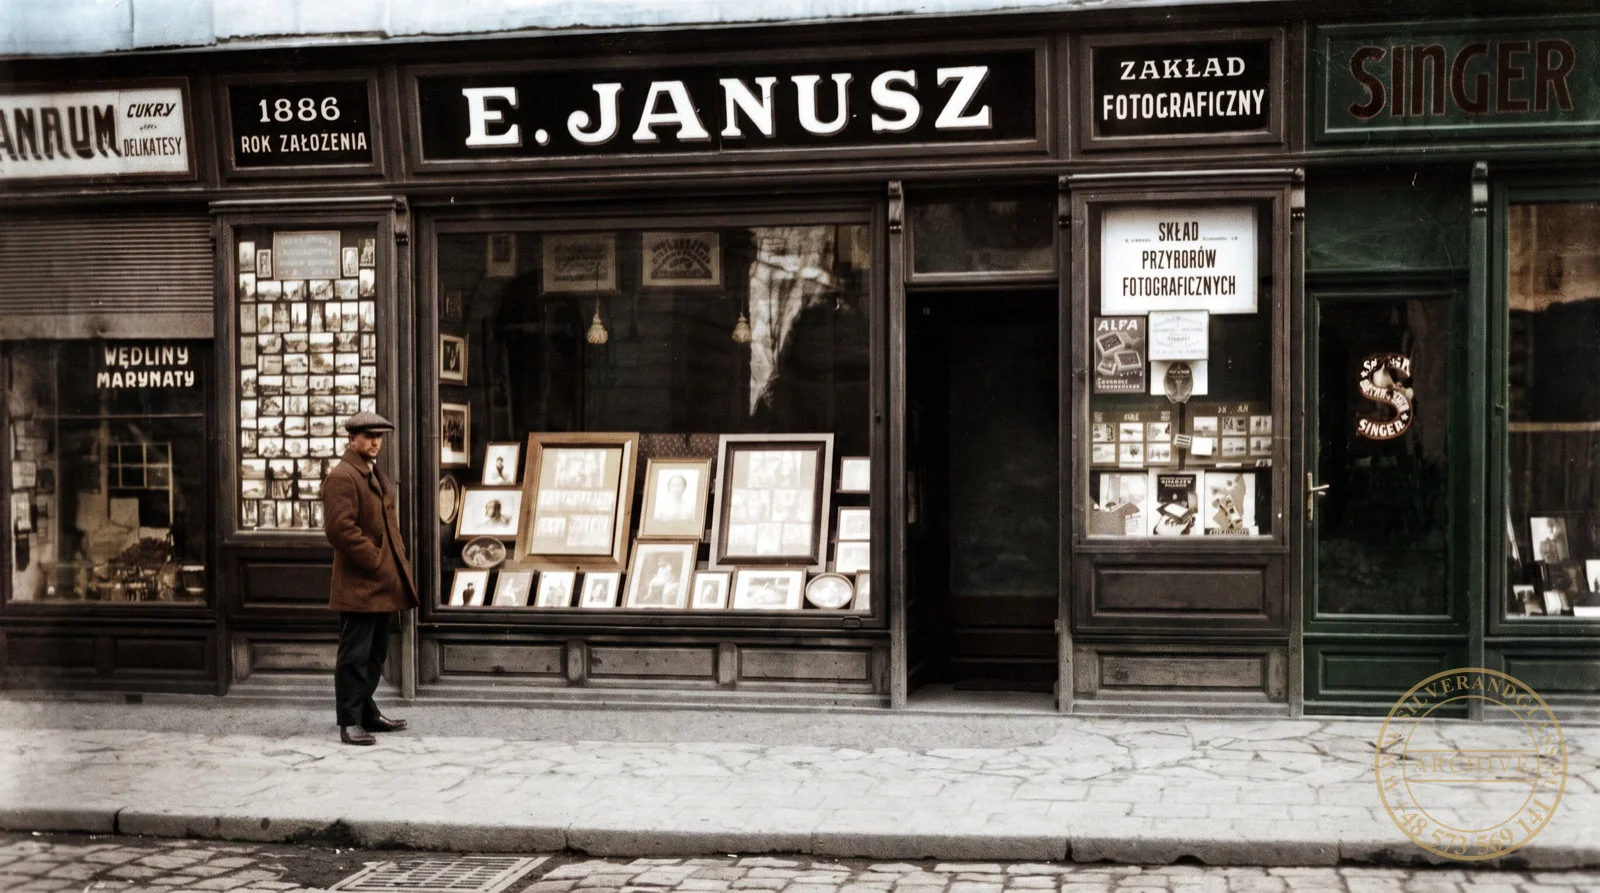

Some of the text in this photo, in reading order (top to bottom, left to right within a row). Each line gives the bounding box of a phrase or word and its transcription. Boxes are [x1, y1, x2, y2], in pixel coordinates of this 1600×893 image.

[1120, 56, 1246, 81] ZAKŁAD
[1348, 39, 1575, 120] SINGER
[127, 103, 176, 118] CUKRY
[258, 96, 341, 123] 1886
[566, 65, 993, 146] JANUSZ
[1103, 88, 1265, 121] FOTOGRAFICZNY
[123, 136, 182, 157] DELIKATESY
[241, 135, 272, 154] ROK
[1158, 221, 1199, 242] SKŁAD
[1122, 275, 1236, 296] FOTOGRAFICZNYCH
[104, 346, 189, 370] WĘDLINY
[96, 370, 195, 389] MARYNATY
[1358, 418, 1406, 437] SINGER
